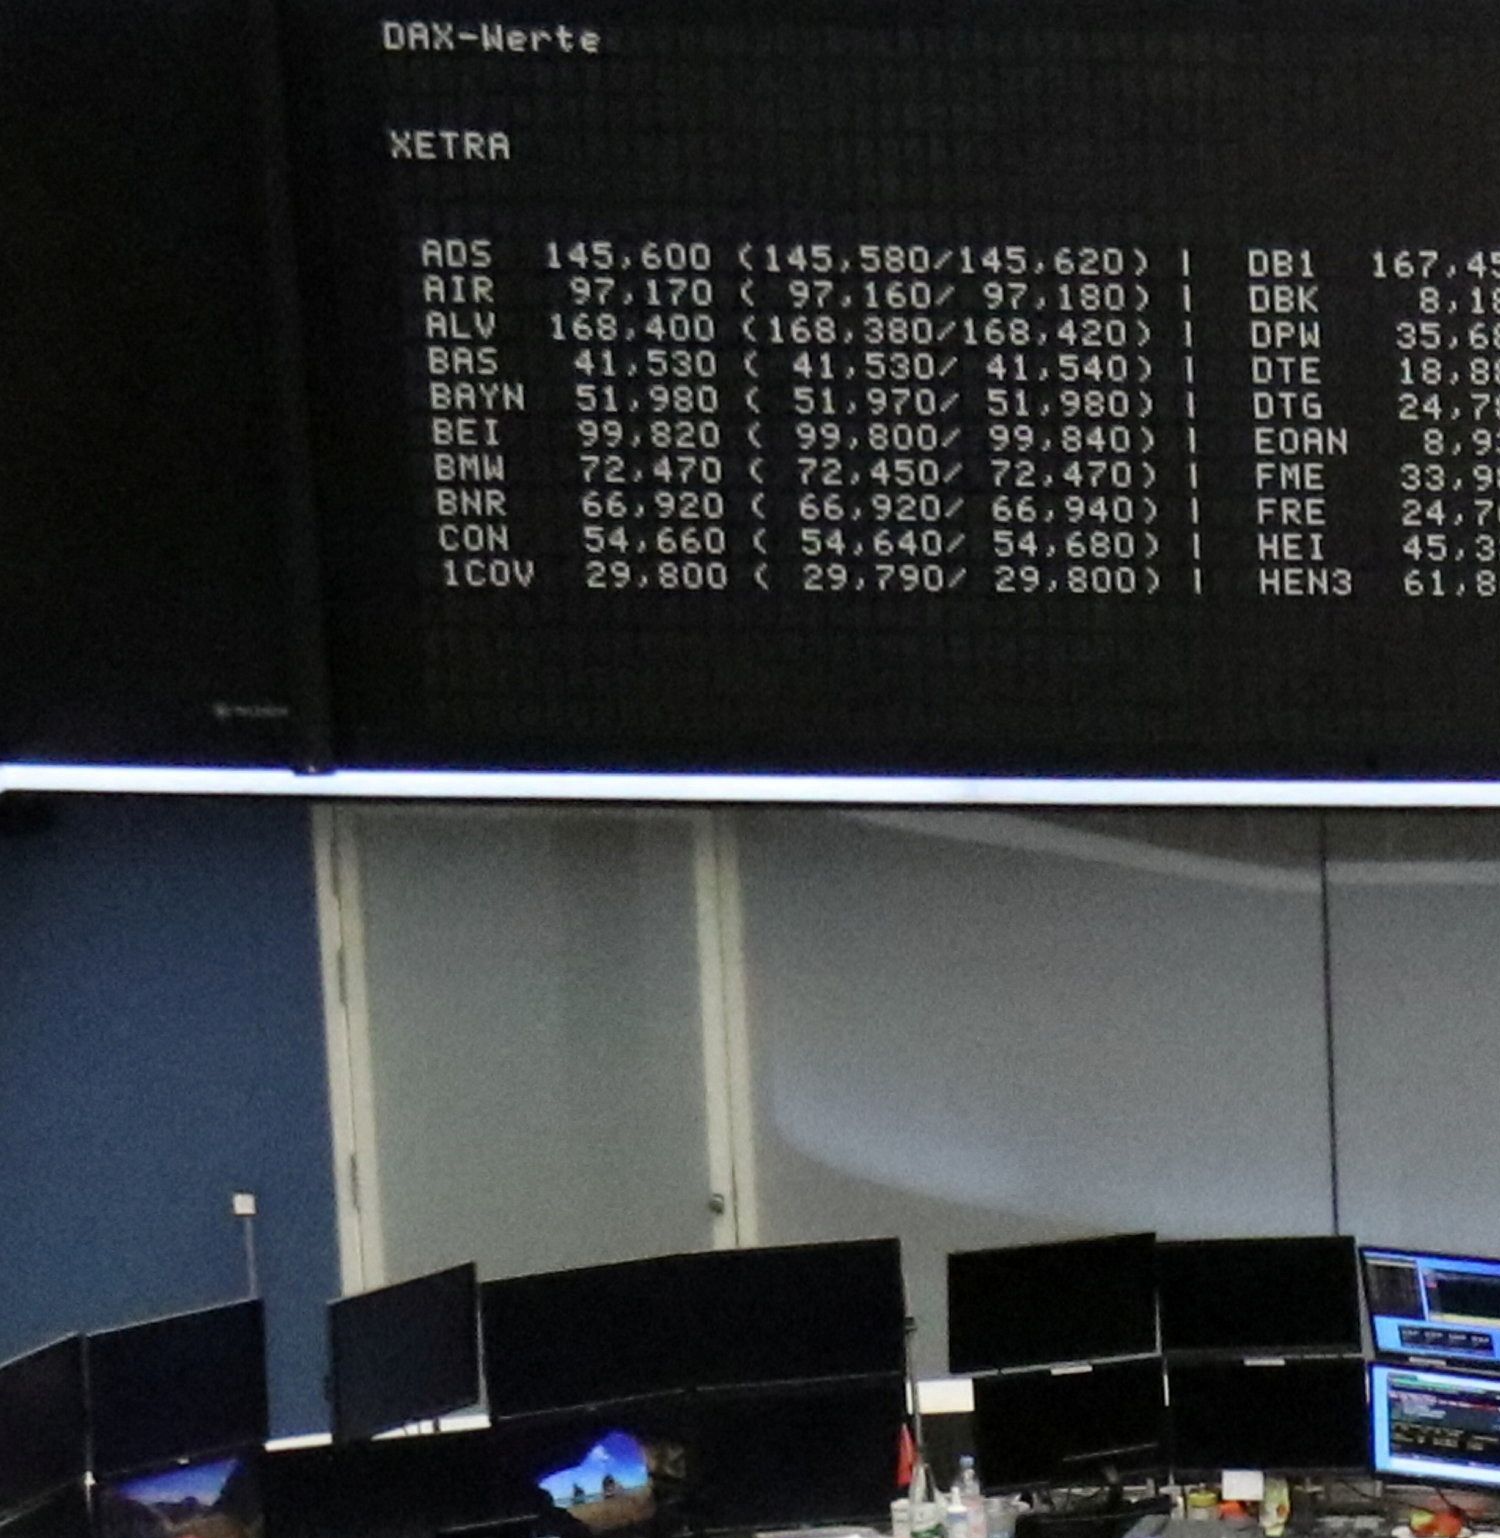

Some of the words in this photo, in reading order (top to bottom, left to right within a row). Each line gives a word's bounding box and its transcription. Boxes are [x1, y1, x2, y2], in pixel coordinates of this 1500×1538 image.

[382, 20, 600, 54] DAX-Werte
[389, 130, 510, 161] XETRA
[421, 238, 492, 268] ADS
[547, 240, 711, 271] 145,600
[1248, 248, 1314, 278] DB1
[423, 274, 494, 303] AIR
[569, 276, 713, 307] 97,170
[1248, 284, 1319, 313] DBK
[425, 310, 496, 340] ALV
[551, 312, 715, 343] 168,400
[1250, 320, 1320, 349] DPW
[427, 345, 498, 375] BAS
[573, 348, 717, 378] 41,530
[1252, 355, 1321, 385] DTE
[429, 381, 525, 411] BAYN
[575, 383, 719, 414] 51,980
[1253, 391, 1323, 420] DTG
[431, 417, 499, 447] BEI
[577, 419, 720, 449] 99,820
[1254, 426, 1348, 455] EOAN
[434, 452, 505, 481] BMW
[580, 454, 722, 484] 72,470
[1255, 462, 1324, 490] FME
[436, 487, 507, 516] BNR
[581, 490, 724, 520] 66,920
[1257, 497, 1326, 526] FRE
[438, 523, 509, 552] CON
[583, 525, 726, 555] 54,660
[1258, 532, 1324, 561] HEI
[443, 558, 535, 587] 1COV
[586, 560, 728, 590] 29,800
[1259, 567, 1352, 596] HEN3
